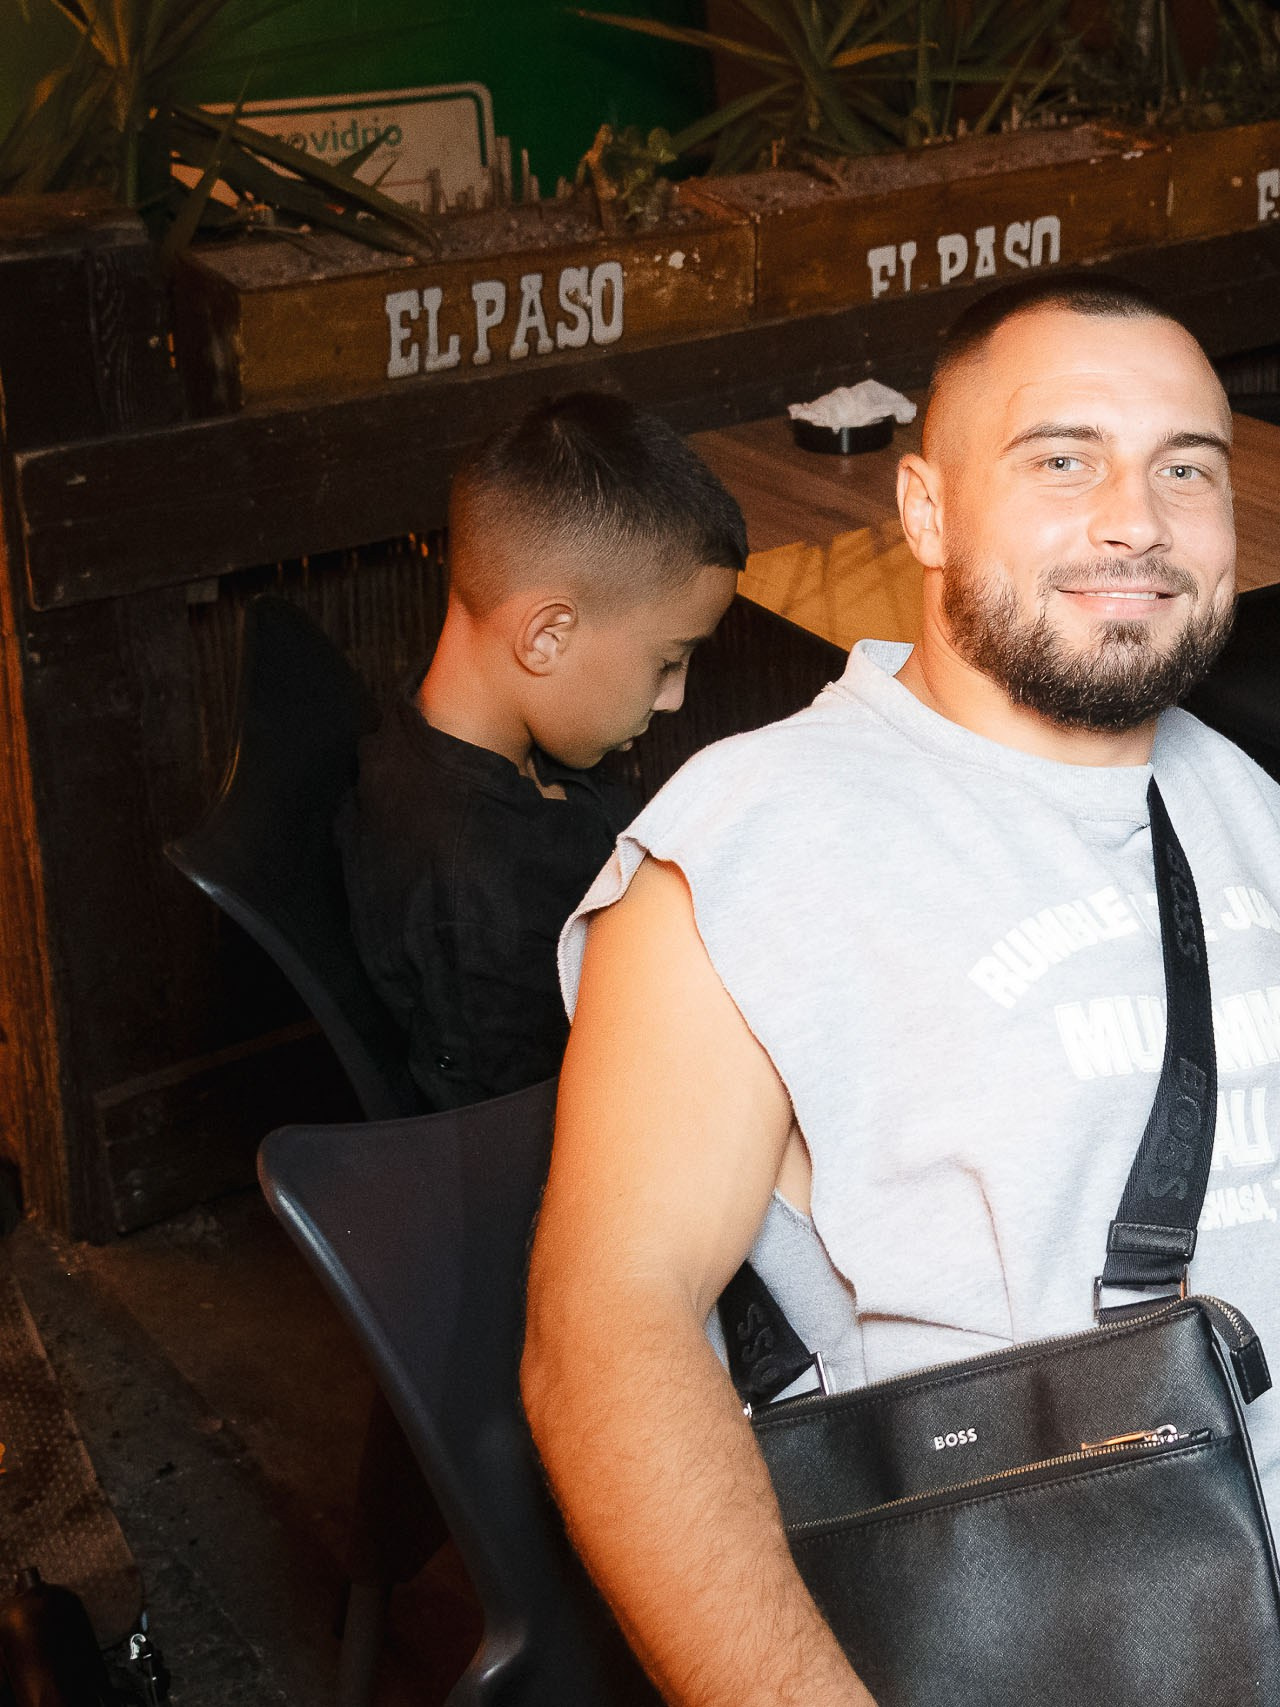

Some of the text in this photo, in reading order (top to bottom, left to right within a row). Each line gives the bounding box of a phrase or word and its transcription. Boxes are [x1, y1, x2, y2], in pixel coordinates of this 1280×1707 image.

[276, 118, 403, 152] ovidrio
[385, 260, 628, 379] EL PASO
[967, 886, 1140, 1009] RUMBLE
[933, 1427, 978, 1451] BOSS
